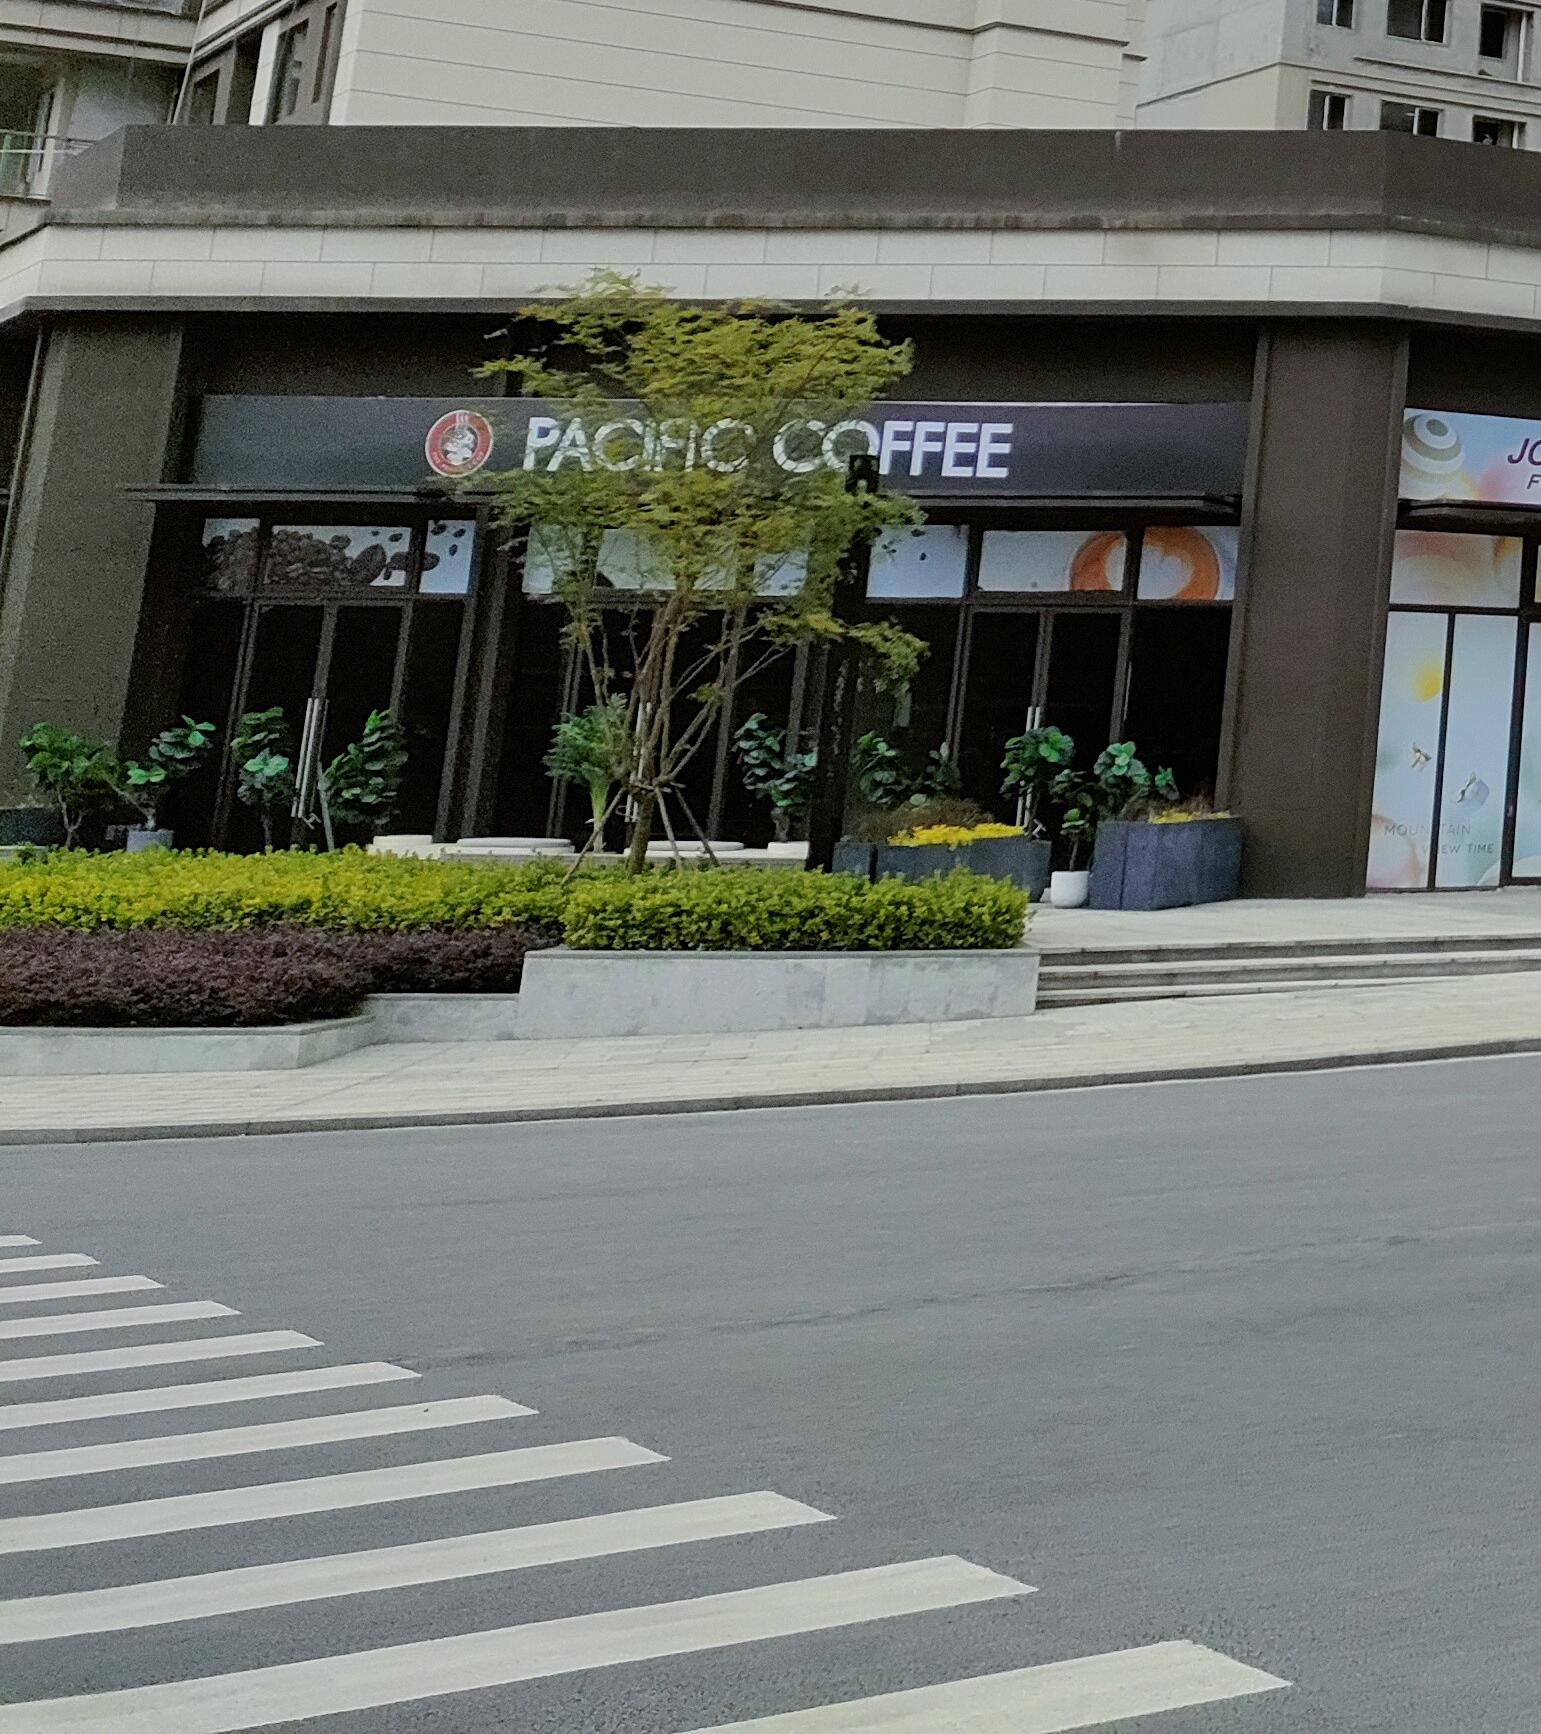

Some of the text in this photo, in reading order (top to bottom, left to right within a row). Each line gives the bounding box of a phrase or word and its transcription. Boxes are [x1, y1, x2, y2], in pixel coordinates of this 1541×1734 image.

[522, 416, 1014, 479] PACIFIC COFFEE
[1384, 823, 1472, 838] MOUNTAIN
[1422, 842, 1495, 855] VEW TIME
